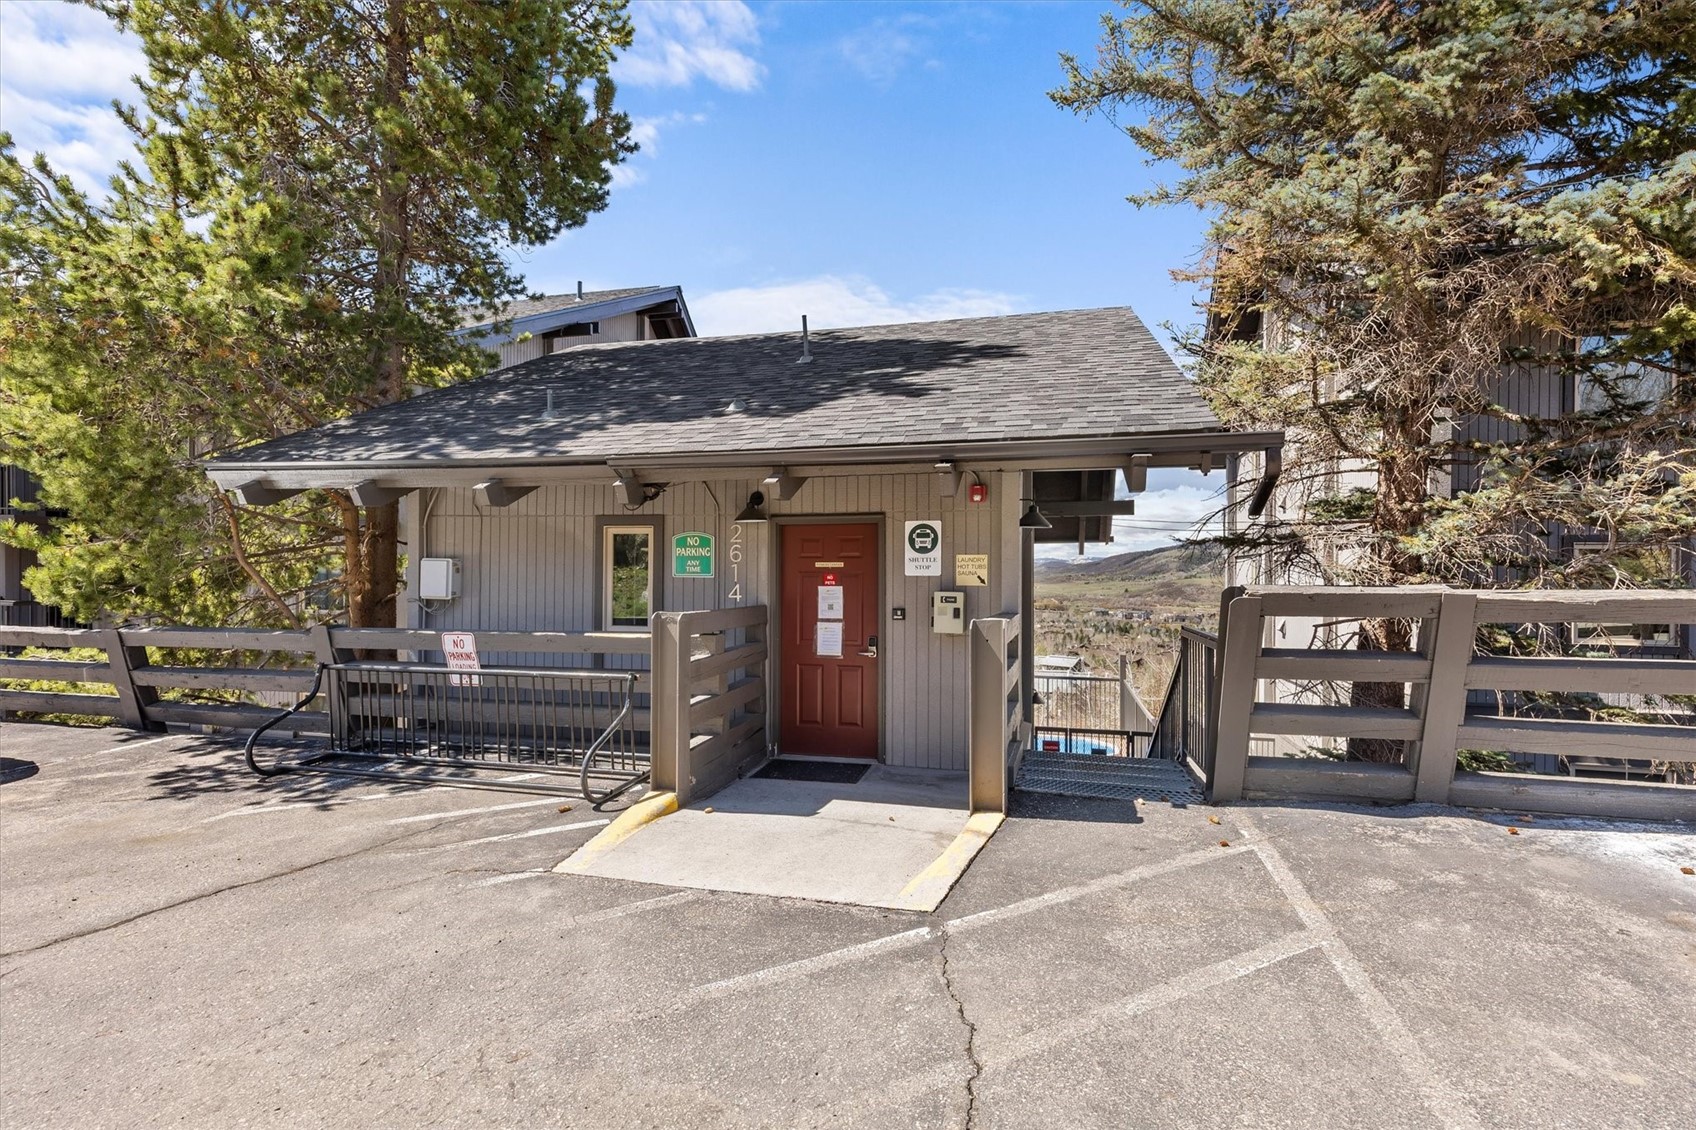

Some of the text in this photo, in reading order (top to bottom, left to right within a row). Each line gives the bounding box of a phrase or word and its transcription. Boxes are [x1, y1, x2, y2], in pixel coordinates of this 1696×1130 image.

[687, 536, 700, 546] NO
[676, 547, 711, 557] PARKING
[728, 524, 742, 602] 2614
[453, 639, 464, 649] NO
[448, 652, 475, 661] PARKING
